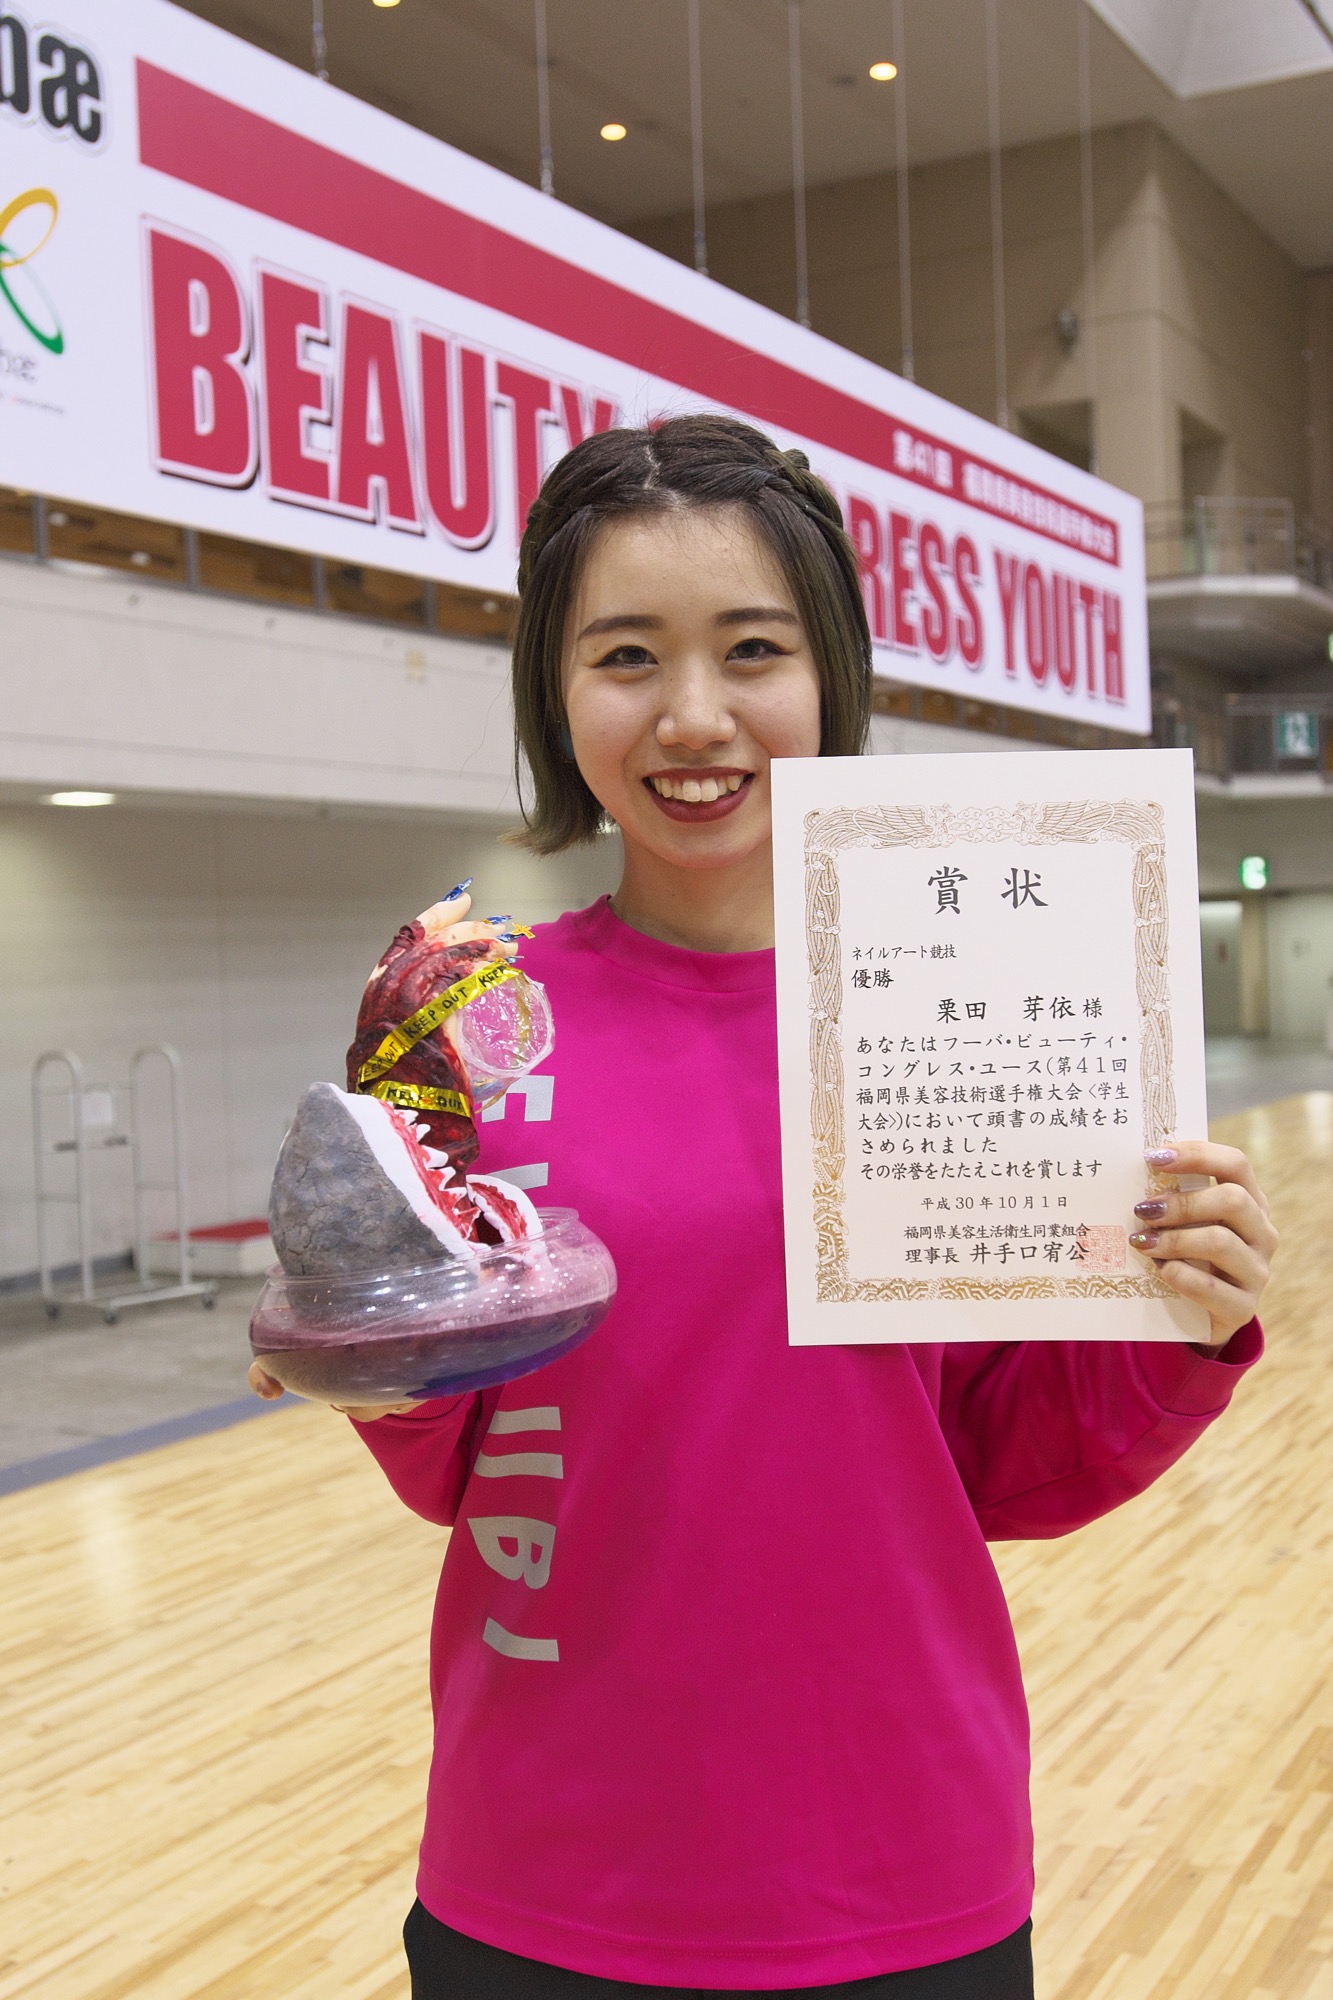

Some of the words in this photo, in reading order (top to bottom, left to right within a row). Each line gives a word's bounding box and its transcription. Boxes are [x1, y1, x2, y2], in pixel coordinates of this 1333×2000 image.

[847, 496, 984, 664] RESS
[993, 549, 1126, 702] YOUTH
[852, 943, 957, 961] ネイルアート競技
[850, 967, 895, 989] 優勝
[384, 1041, 399, 1062] OUT
[403, 1010, 436, 1039] KEEP
[441, 986, 468, 1009] OUT
[861, 1136, 998, 1155] さめられました
[860, 1158, 1103, 1181] その栄誉をたたえこれを賞します
[903, 1222, 1092, 1240] 福岡県美容生活衛生同業組合
[904, 1246, 960, 1265] 理事長
